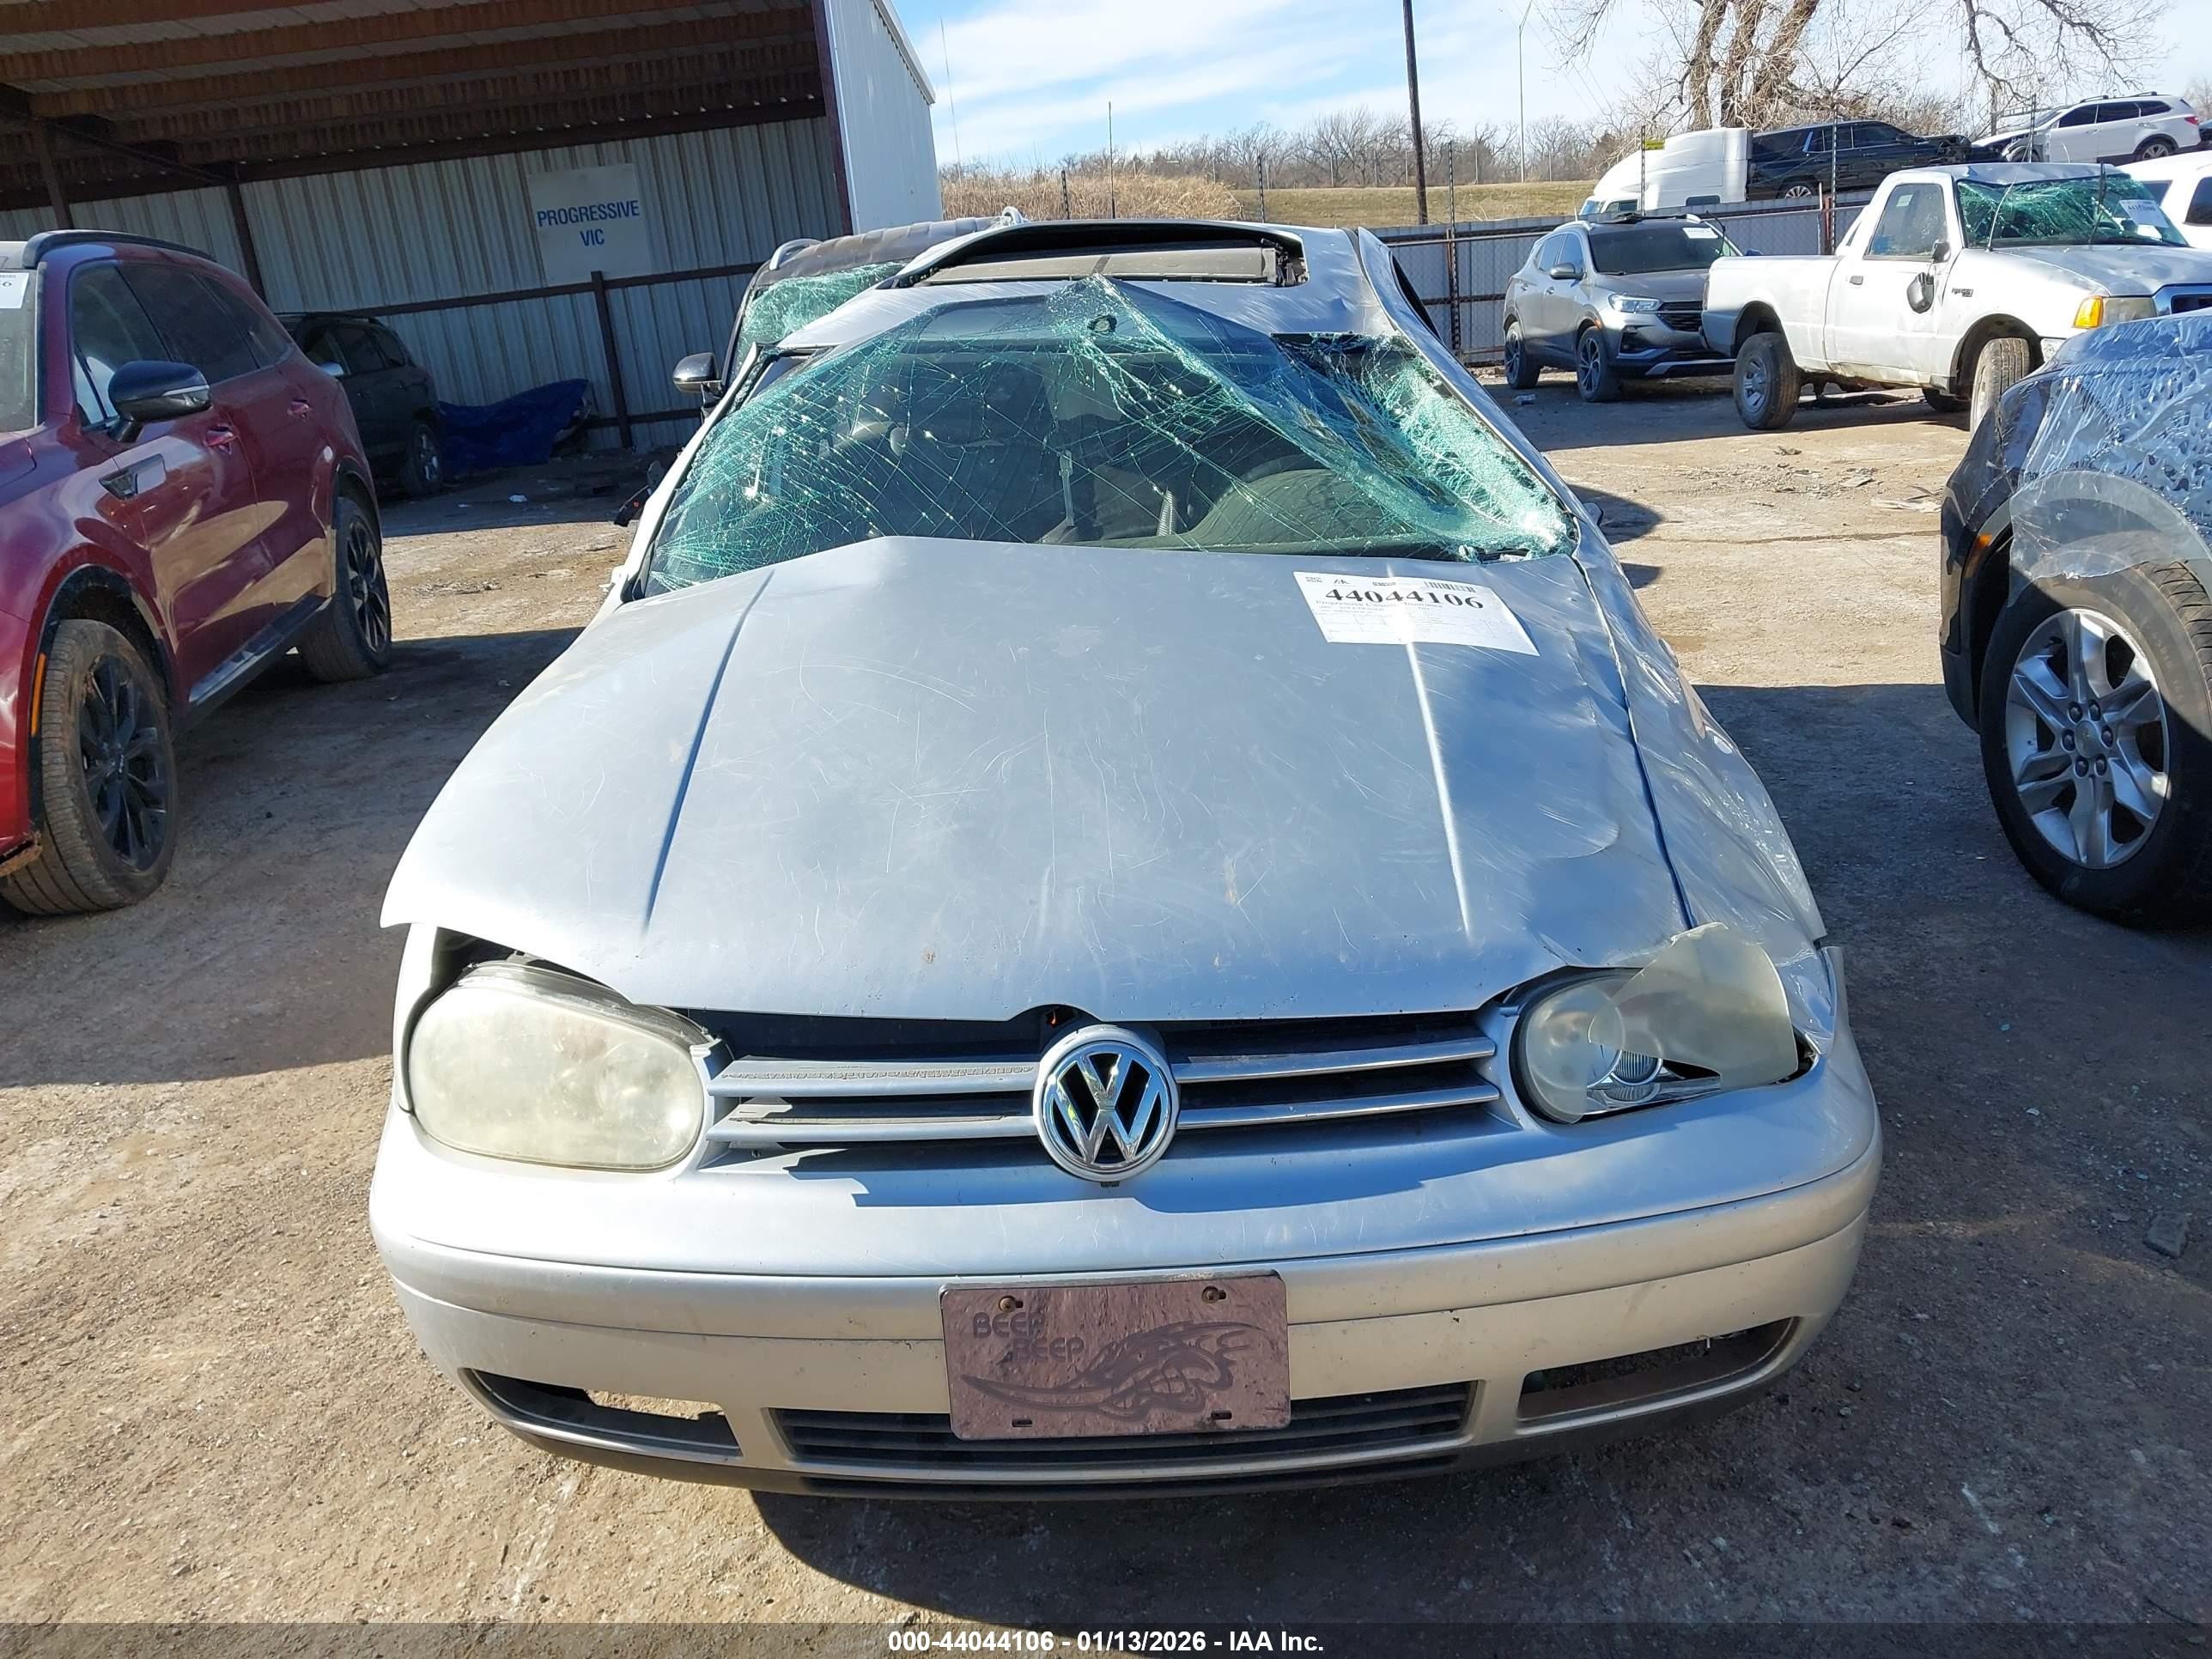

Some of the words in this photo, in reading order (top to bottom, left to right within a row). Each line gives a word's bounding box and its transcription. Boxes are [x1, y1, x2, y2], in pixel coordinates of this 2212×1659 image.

[537, 199, 640, 228] PROGRESSIVE
[580, 228, 605, 246] VIC
[1325, 588, 1484, 609] 44044106
[1038, 1033, 1175, 1177] VW
[972, 1311, 1044, 1340] BEEP
[1012, 1336, 1085, 1364] BEEP
